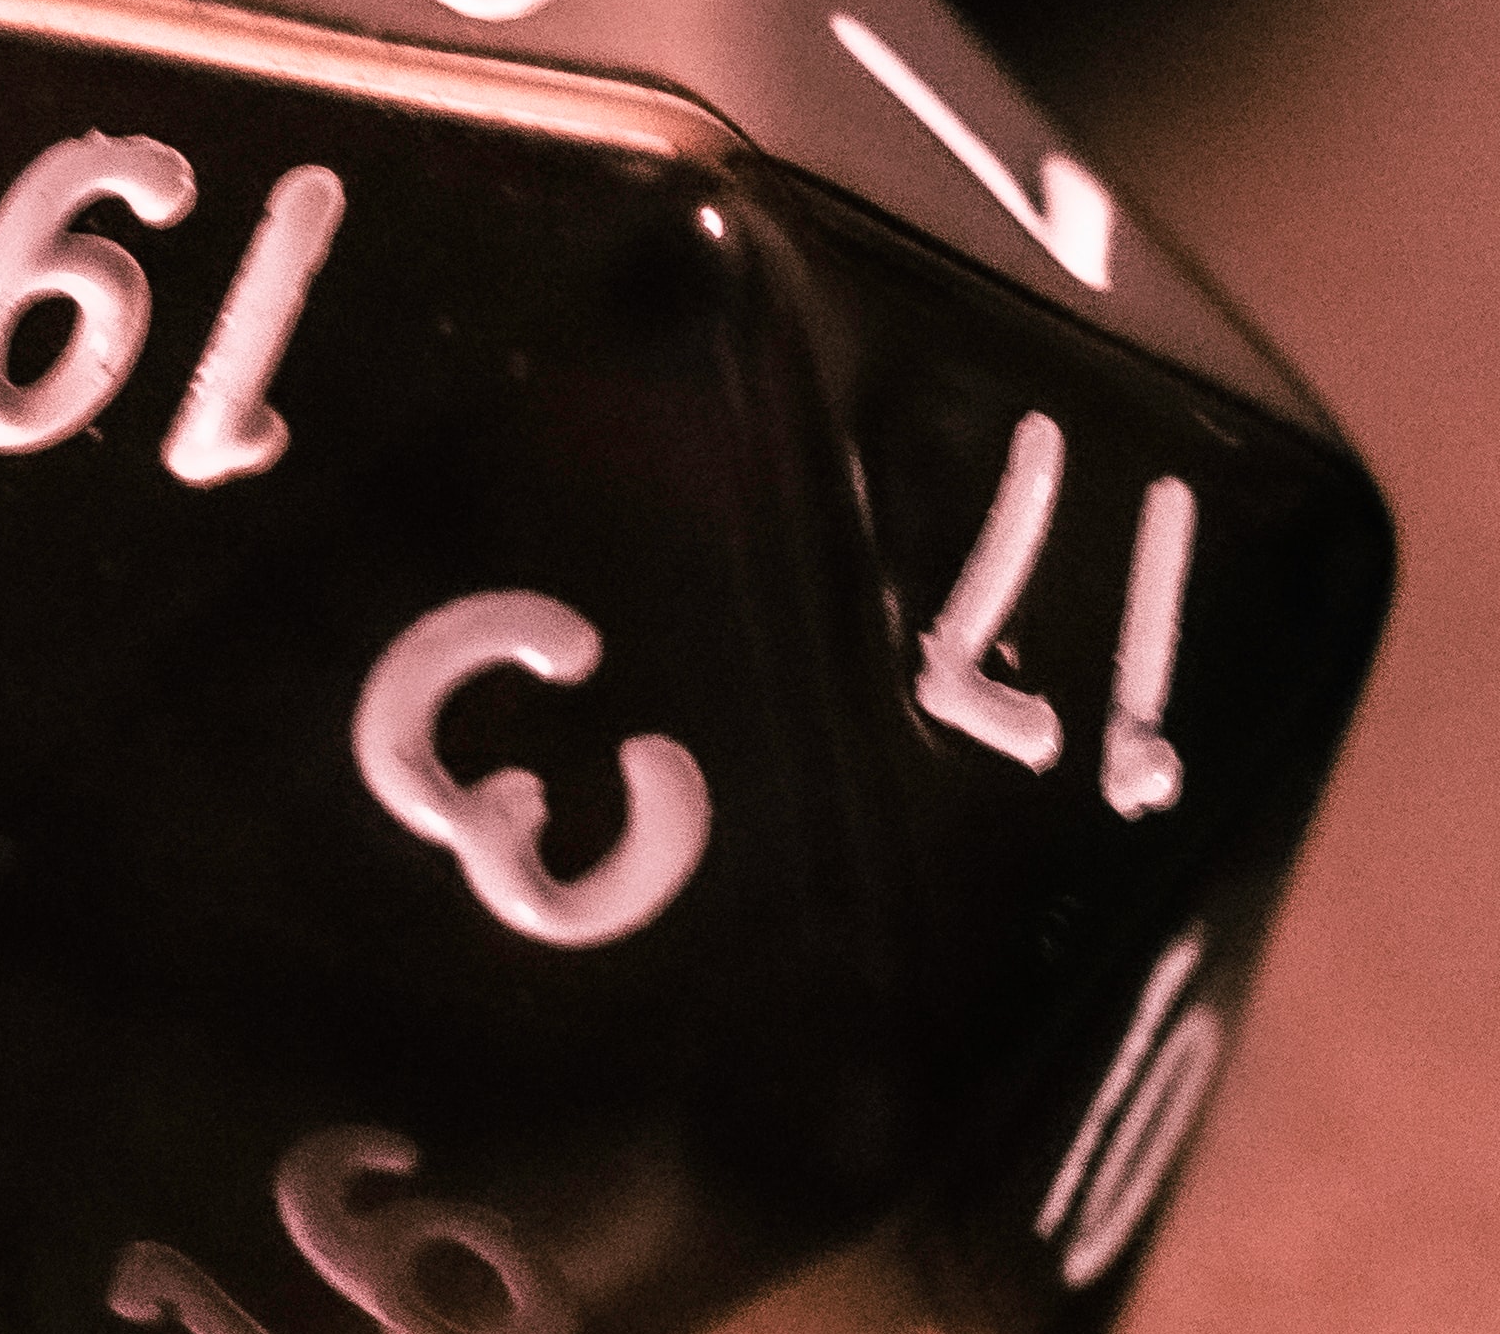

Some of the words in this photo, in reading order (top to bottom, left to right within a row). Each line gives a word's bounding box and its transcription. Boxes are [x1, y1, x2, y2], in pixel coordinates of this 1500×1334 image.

[352, 589, 712, 947] 3
[915, 410, 1196, 819] 17
[1035, 919, 1222, 1287] 10
